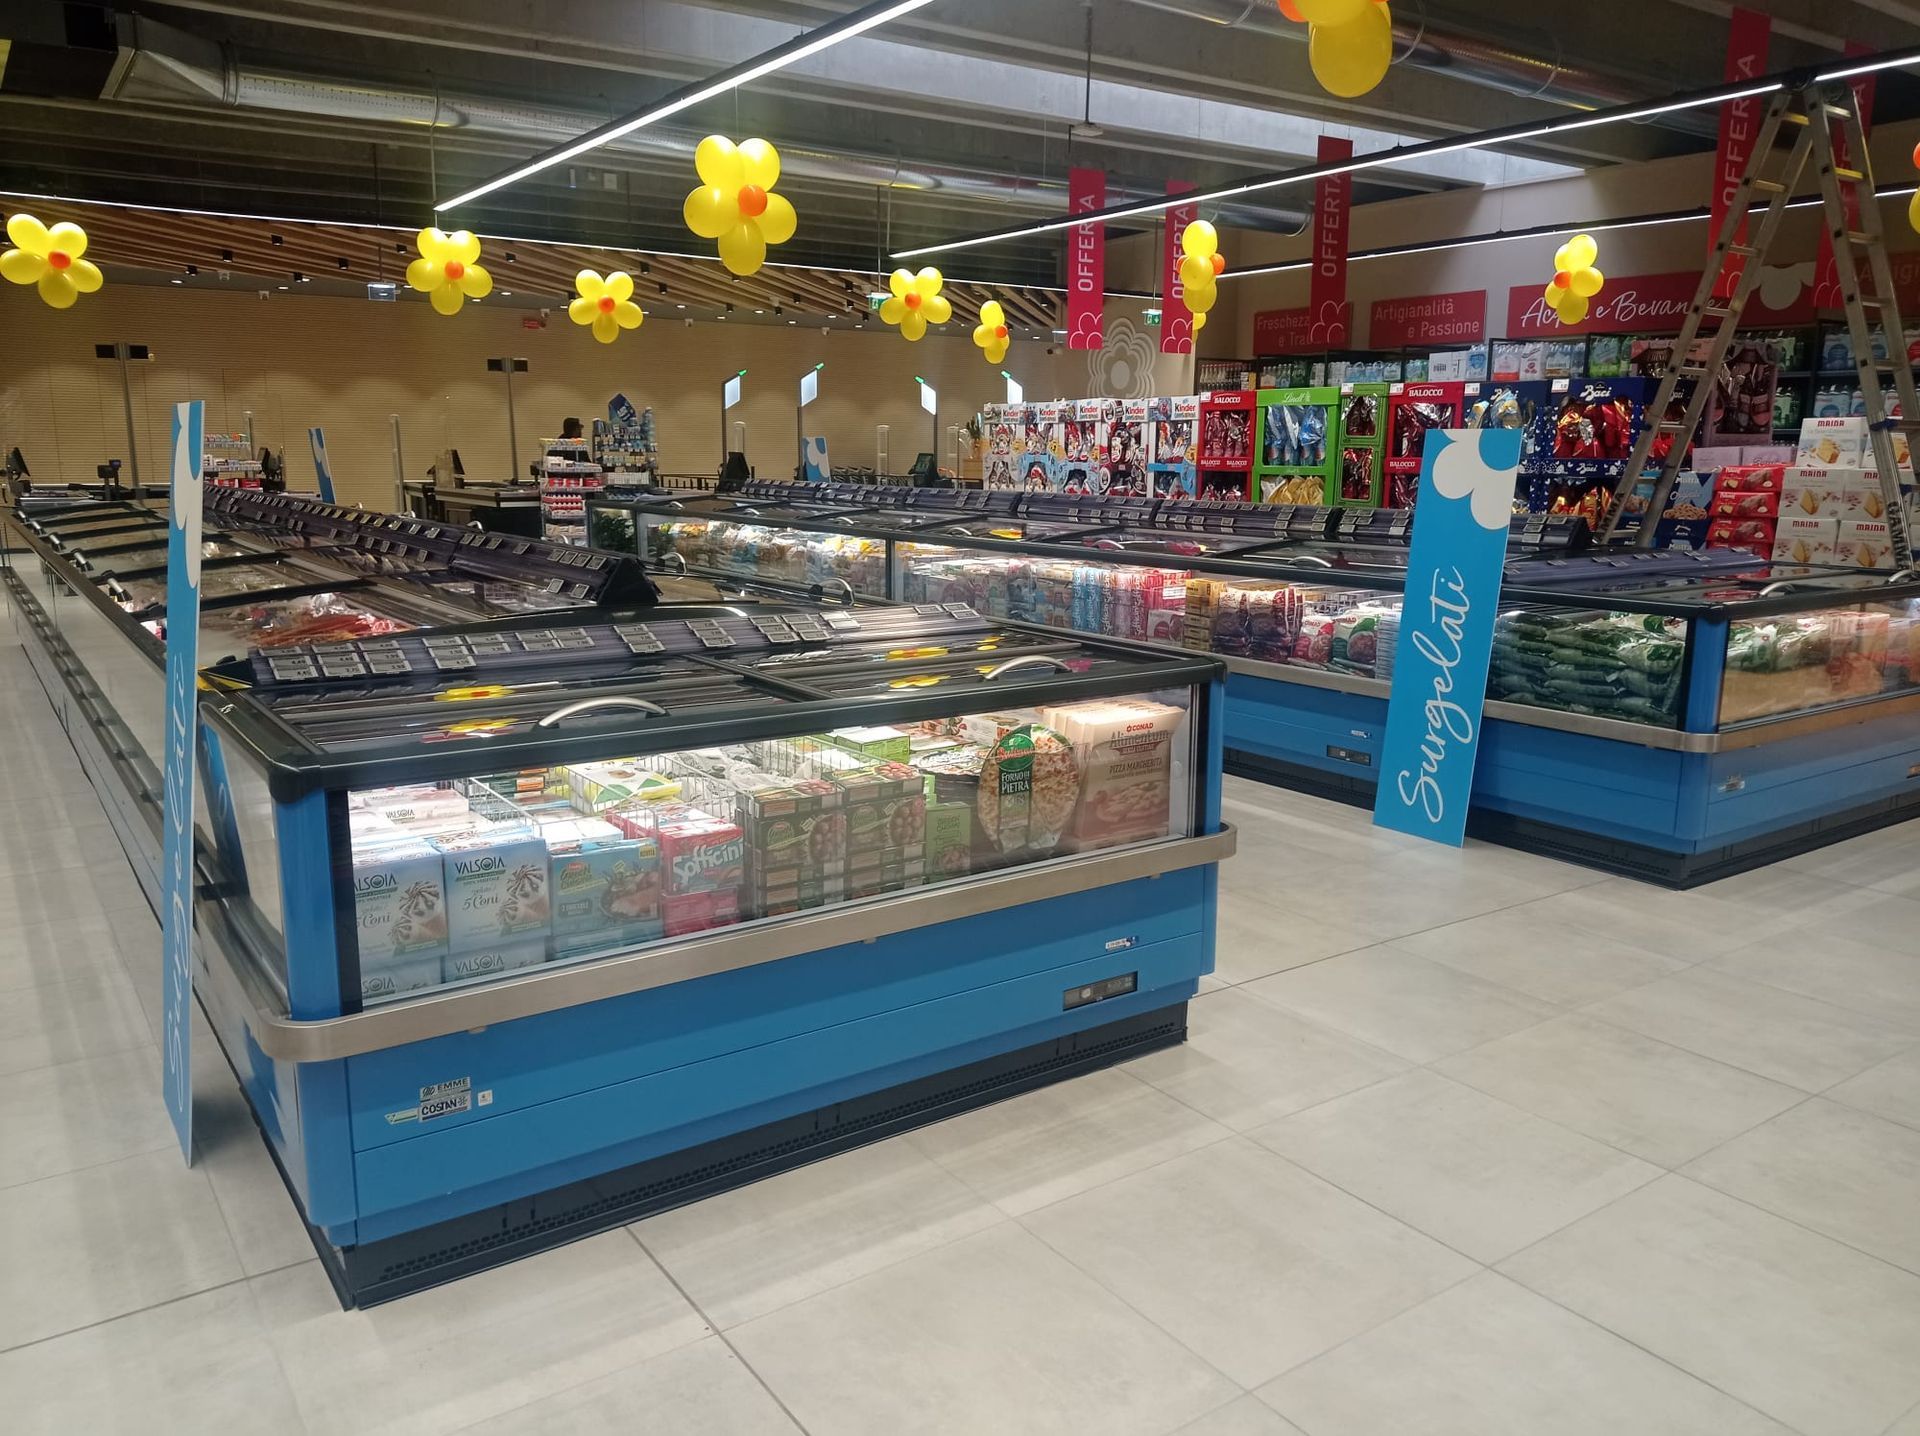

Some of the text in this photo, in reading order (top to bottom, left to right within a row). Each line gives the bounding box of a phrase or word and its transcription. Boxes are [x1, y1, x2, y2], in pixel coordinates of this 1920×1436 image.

[1722, 54, 1755, 206] OFFERA
[1077, 194, 1095, 292] OFFERA
[1375, 298, 1455, 323] Artigianalità
[1610, 291, 1721, 322] Bevane
[1408, 319, 1480, 338] e Passione
[1408, 388, 1444, 397] BALOCCO
[1580, 385, 1613, 402] Baci
[1398, 566, 1473, 824] Surgelati
[1001, 780, 1030, 794] PIETRA
[455, 856, 505, 875] VALSOIA
[673, 836, 744, 886] Sofficini
[455, 954, 504, 973] VALSOIA
[421, 1099, 457, 1116] COSTAN
